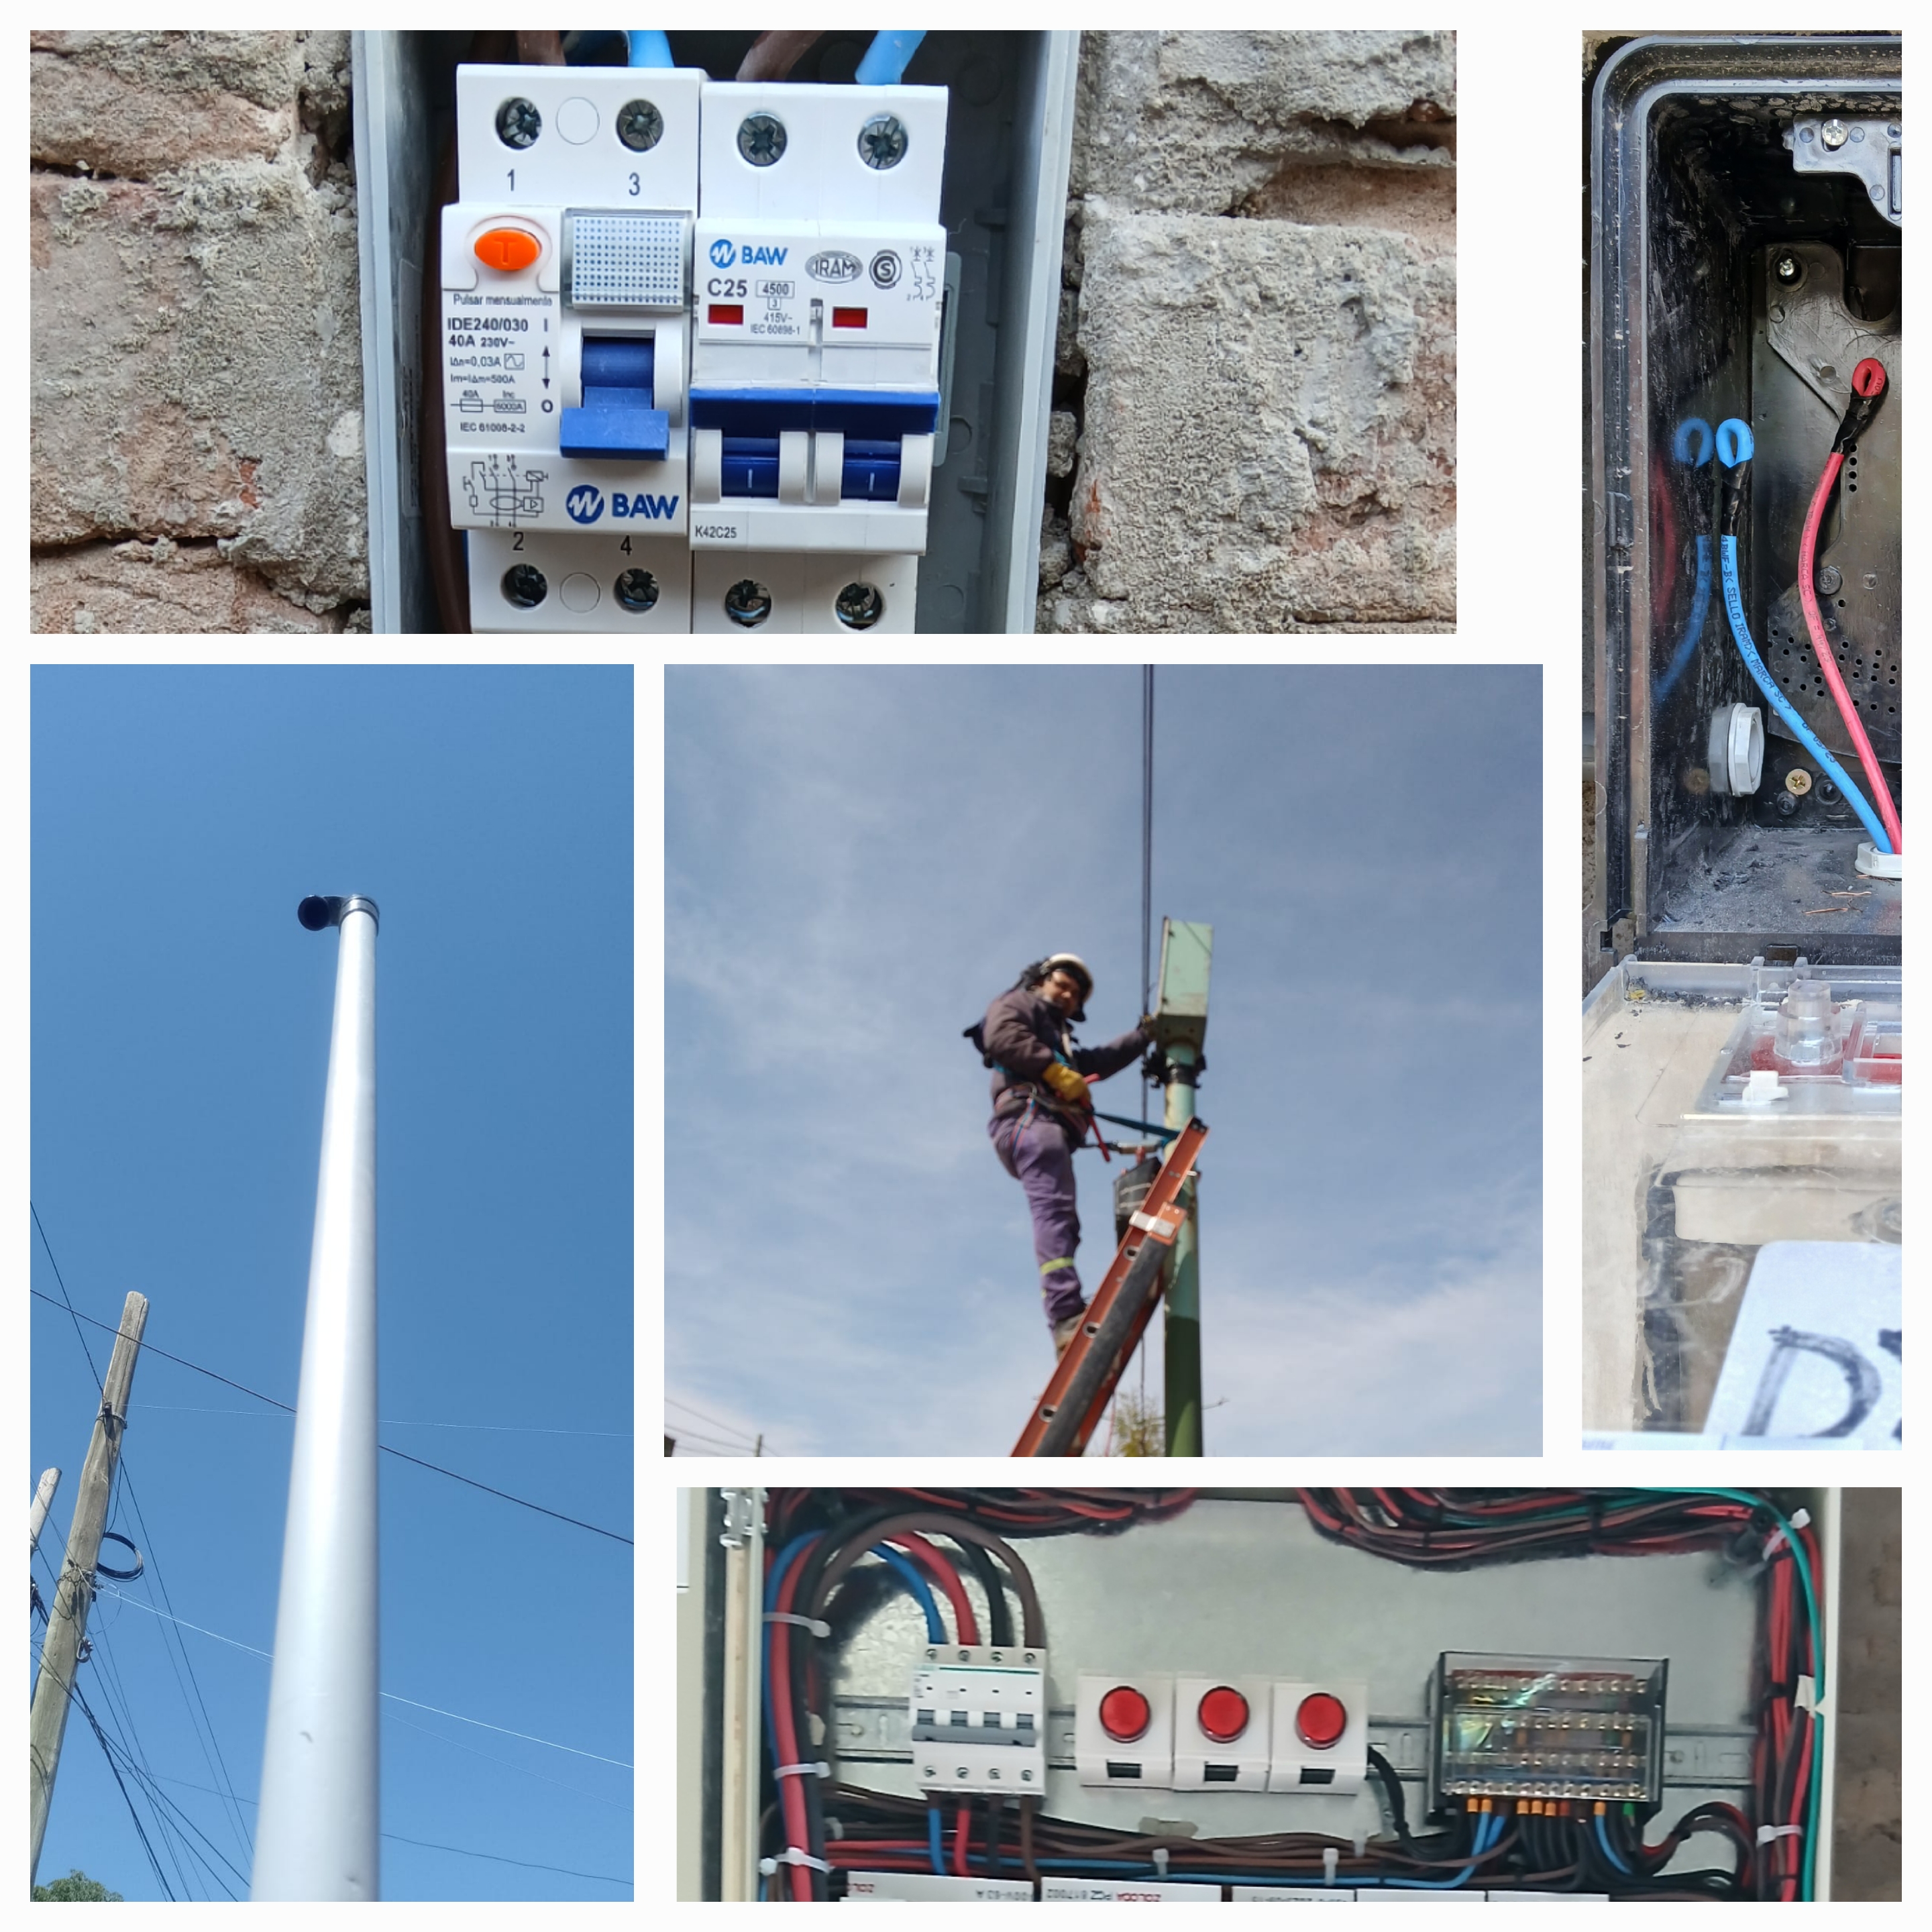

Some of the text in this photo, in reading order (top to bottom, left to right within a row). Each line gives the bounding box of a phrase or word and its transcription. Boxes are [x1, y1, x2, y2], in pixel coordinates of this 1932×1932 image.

[507, 168, 515, 192] 1
[628, 173, 641, 195] 3
[741, 246, 788, 266] BAW
[814, 257, 857, 277] IRAM
[708, 278, 747, 297] C25
[763, 282, 790, 295] 4500
[453, 293, 483, 306] Pulsar
[447, 317, 529, 332] IDE240/030
[750, 324, 765, 334] IEC
[448, 334, 475, 347] 40A
[460, 421, 476, 432] IEC
[612, 492, 679, 520] BAW
[695, 525, 737, 539] K42C25
[513, 533, 524, 551] 2
[620, 535, 632, 555] 4
[1726, 587, 1741, 621] SELLO
[1750, 658, 1775, 690] MARCA
